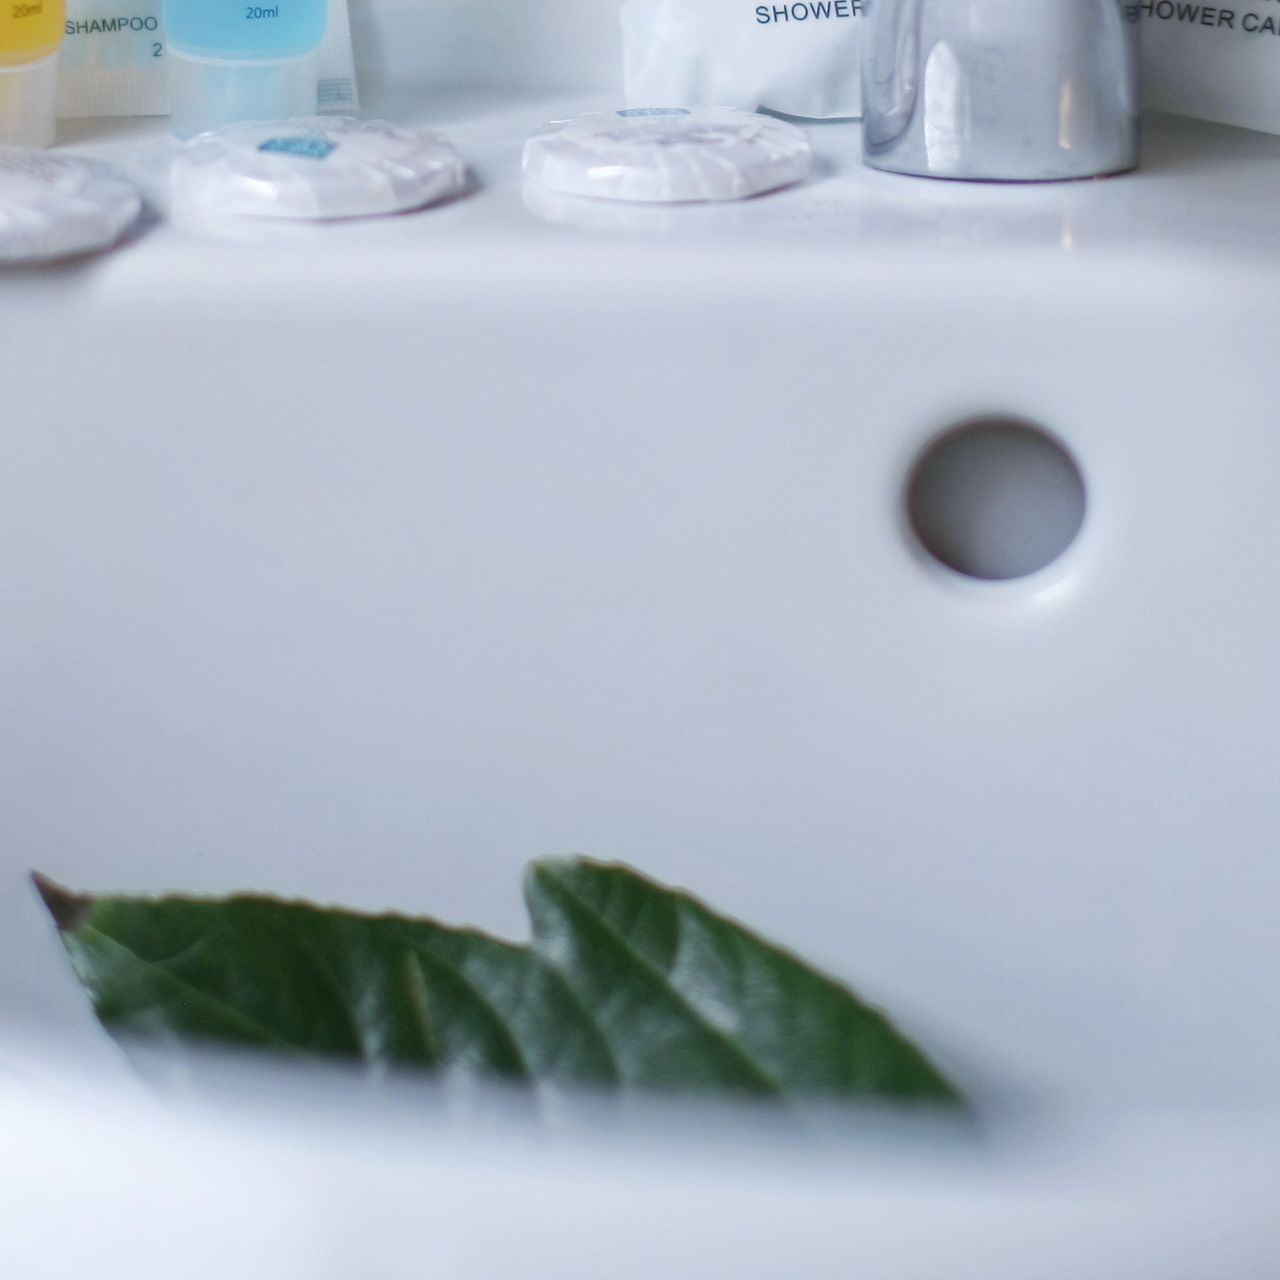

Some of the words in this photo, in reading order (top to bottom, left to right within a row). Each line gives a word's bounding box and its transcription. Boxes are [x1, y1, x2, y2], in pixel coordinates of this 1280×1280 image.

[245, 5, 279, 19] 20ml
[1139, 0, 1234, 29] HOWER
[64, 16, 158, 35] SHAMPOO
